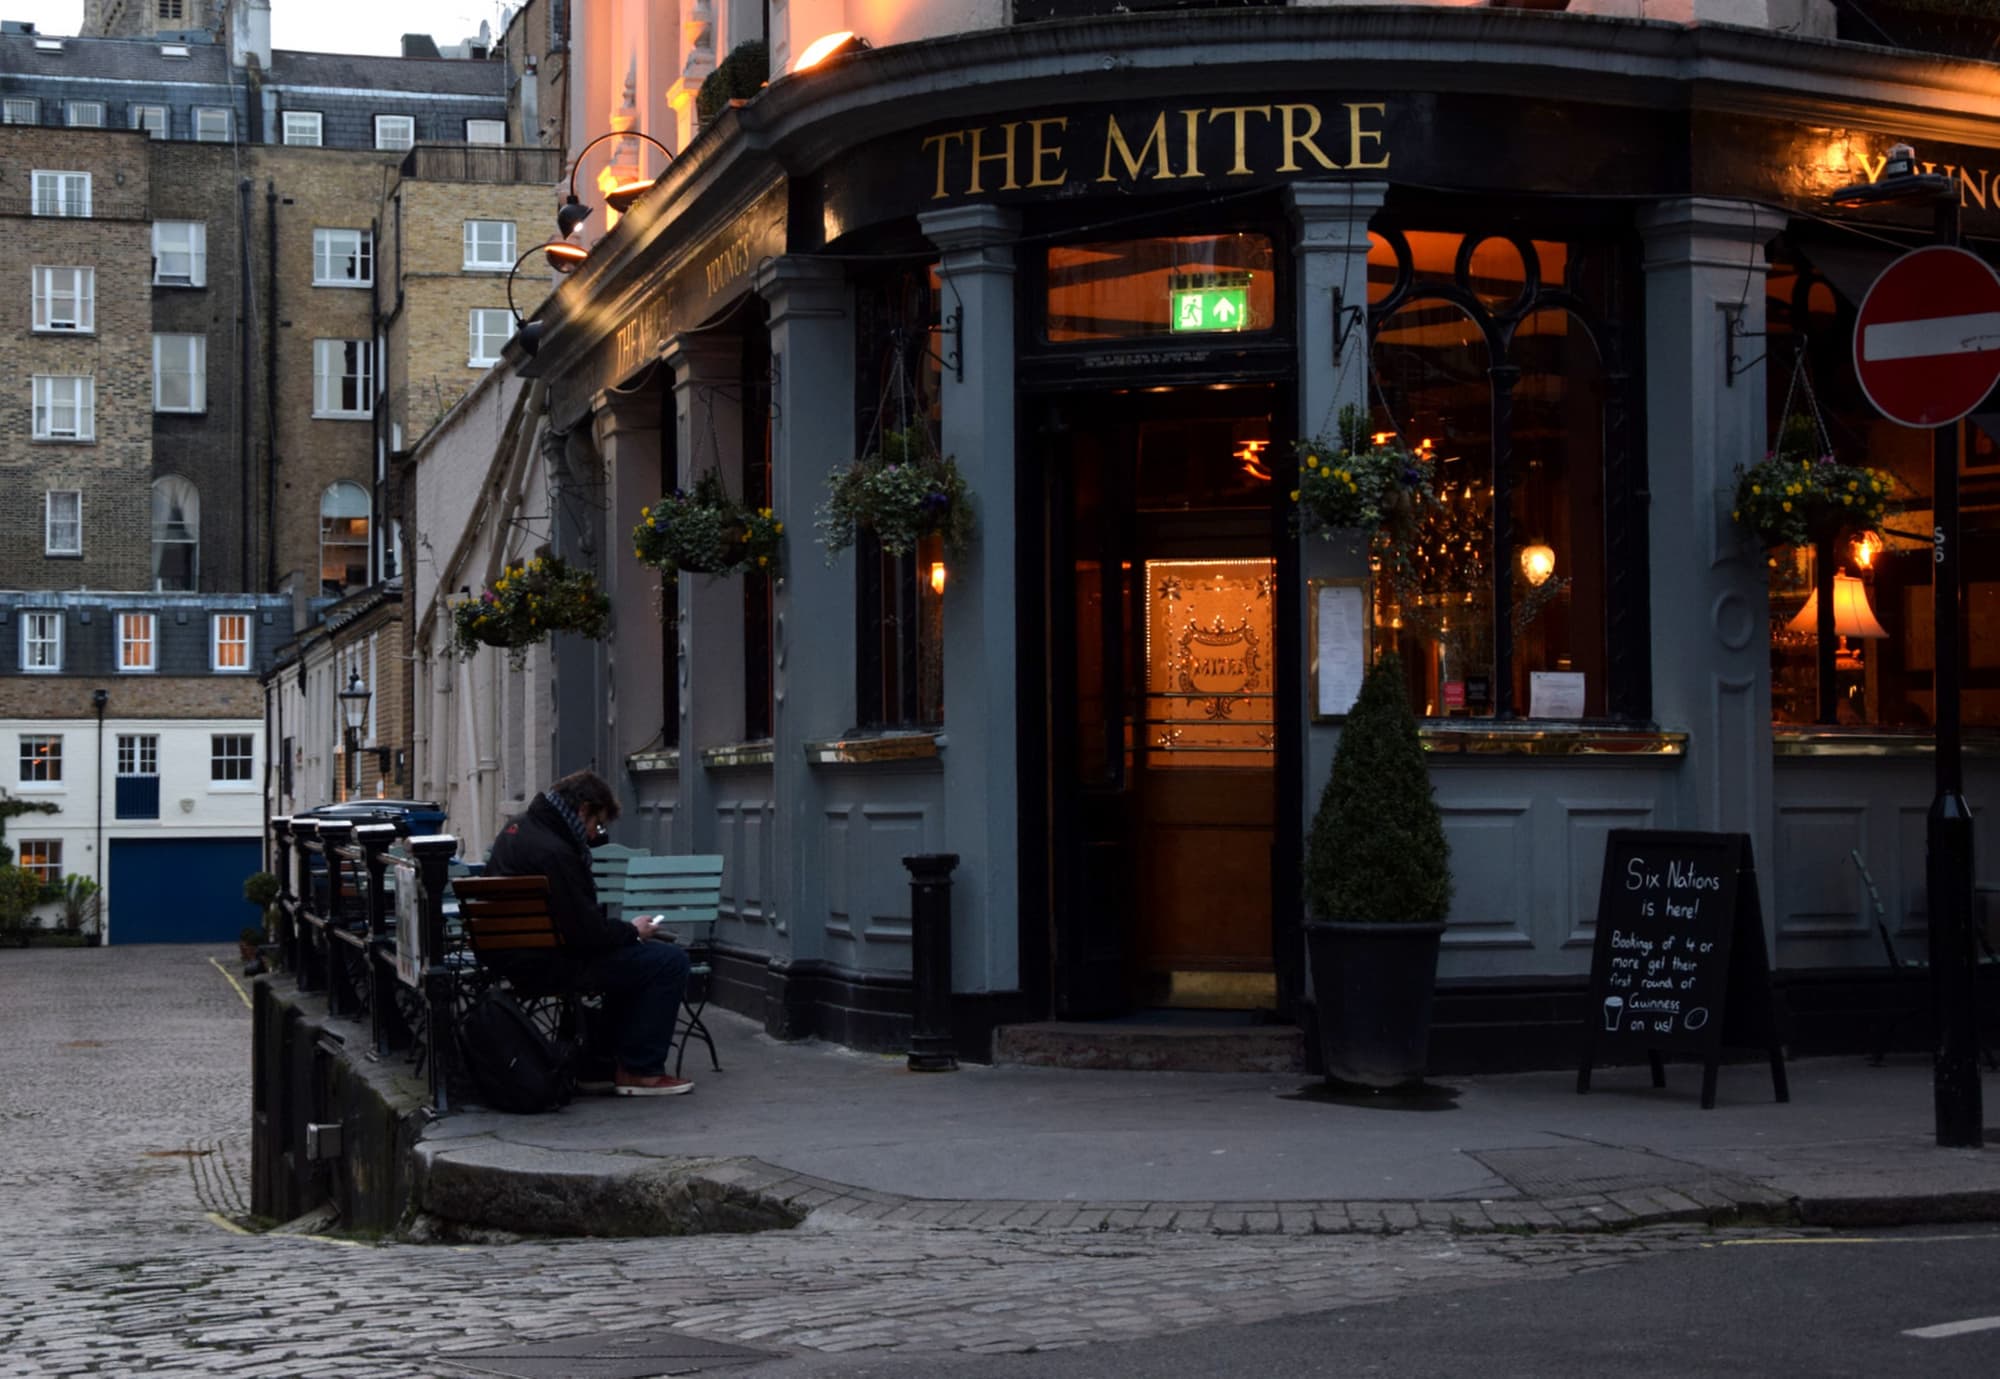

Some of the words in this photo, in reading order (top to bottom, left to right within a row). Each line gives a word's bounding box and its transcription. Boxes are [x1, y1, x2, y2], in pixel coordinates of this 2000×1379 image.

[921, 116, 1069, 200] THE
[1096, 102, 1392, 183] MITRE
[616, 318, 637, 378] THE
[1626, 857, 1660, 890] Six
[1667, 860, 1720, 890] Nations
[1641, 899, 1655, 917] is
[1665, 897, 1700, 919] here!
[1611, 929, 1653, 956] Bookings
[1662, 935, 1676, 950] of
[1686, 937, 1696, 952] 4
[1700, 942, 1713, 953] or
[1612, 957, 1639, 969] more
[1647, 956, 1665, 976] get
[1672, 956, 1697, 971] their
[1610, 972, 1632, 987] first
[1641, 977, 1673, 989] round
[1680, 976, 1696, 989] of
[1628, 992, 1680, 1009] Guinness
[1630, 1020, 1645, 1031] on
[1654, 1016, 1673, 1033] us!
